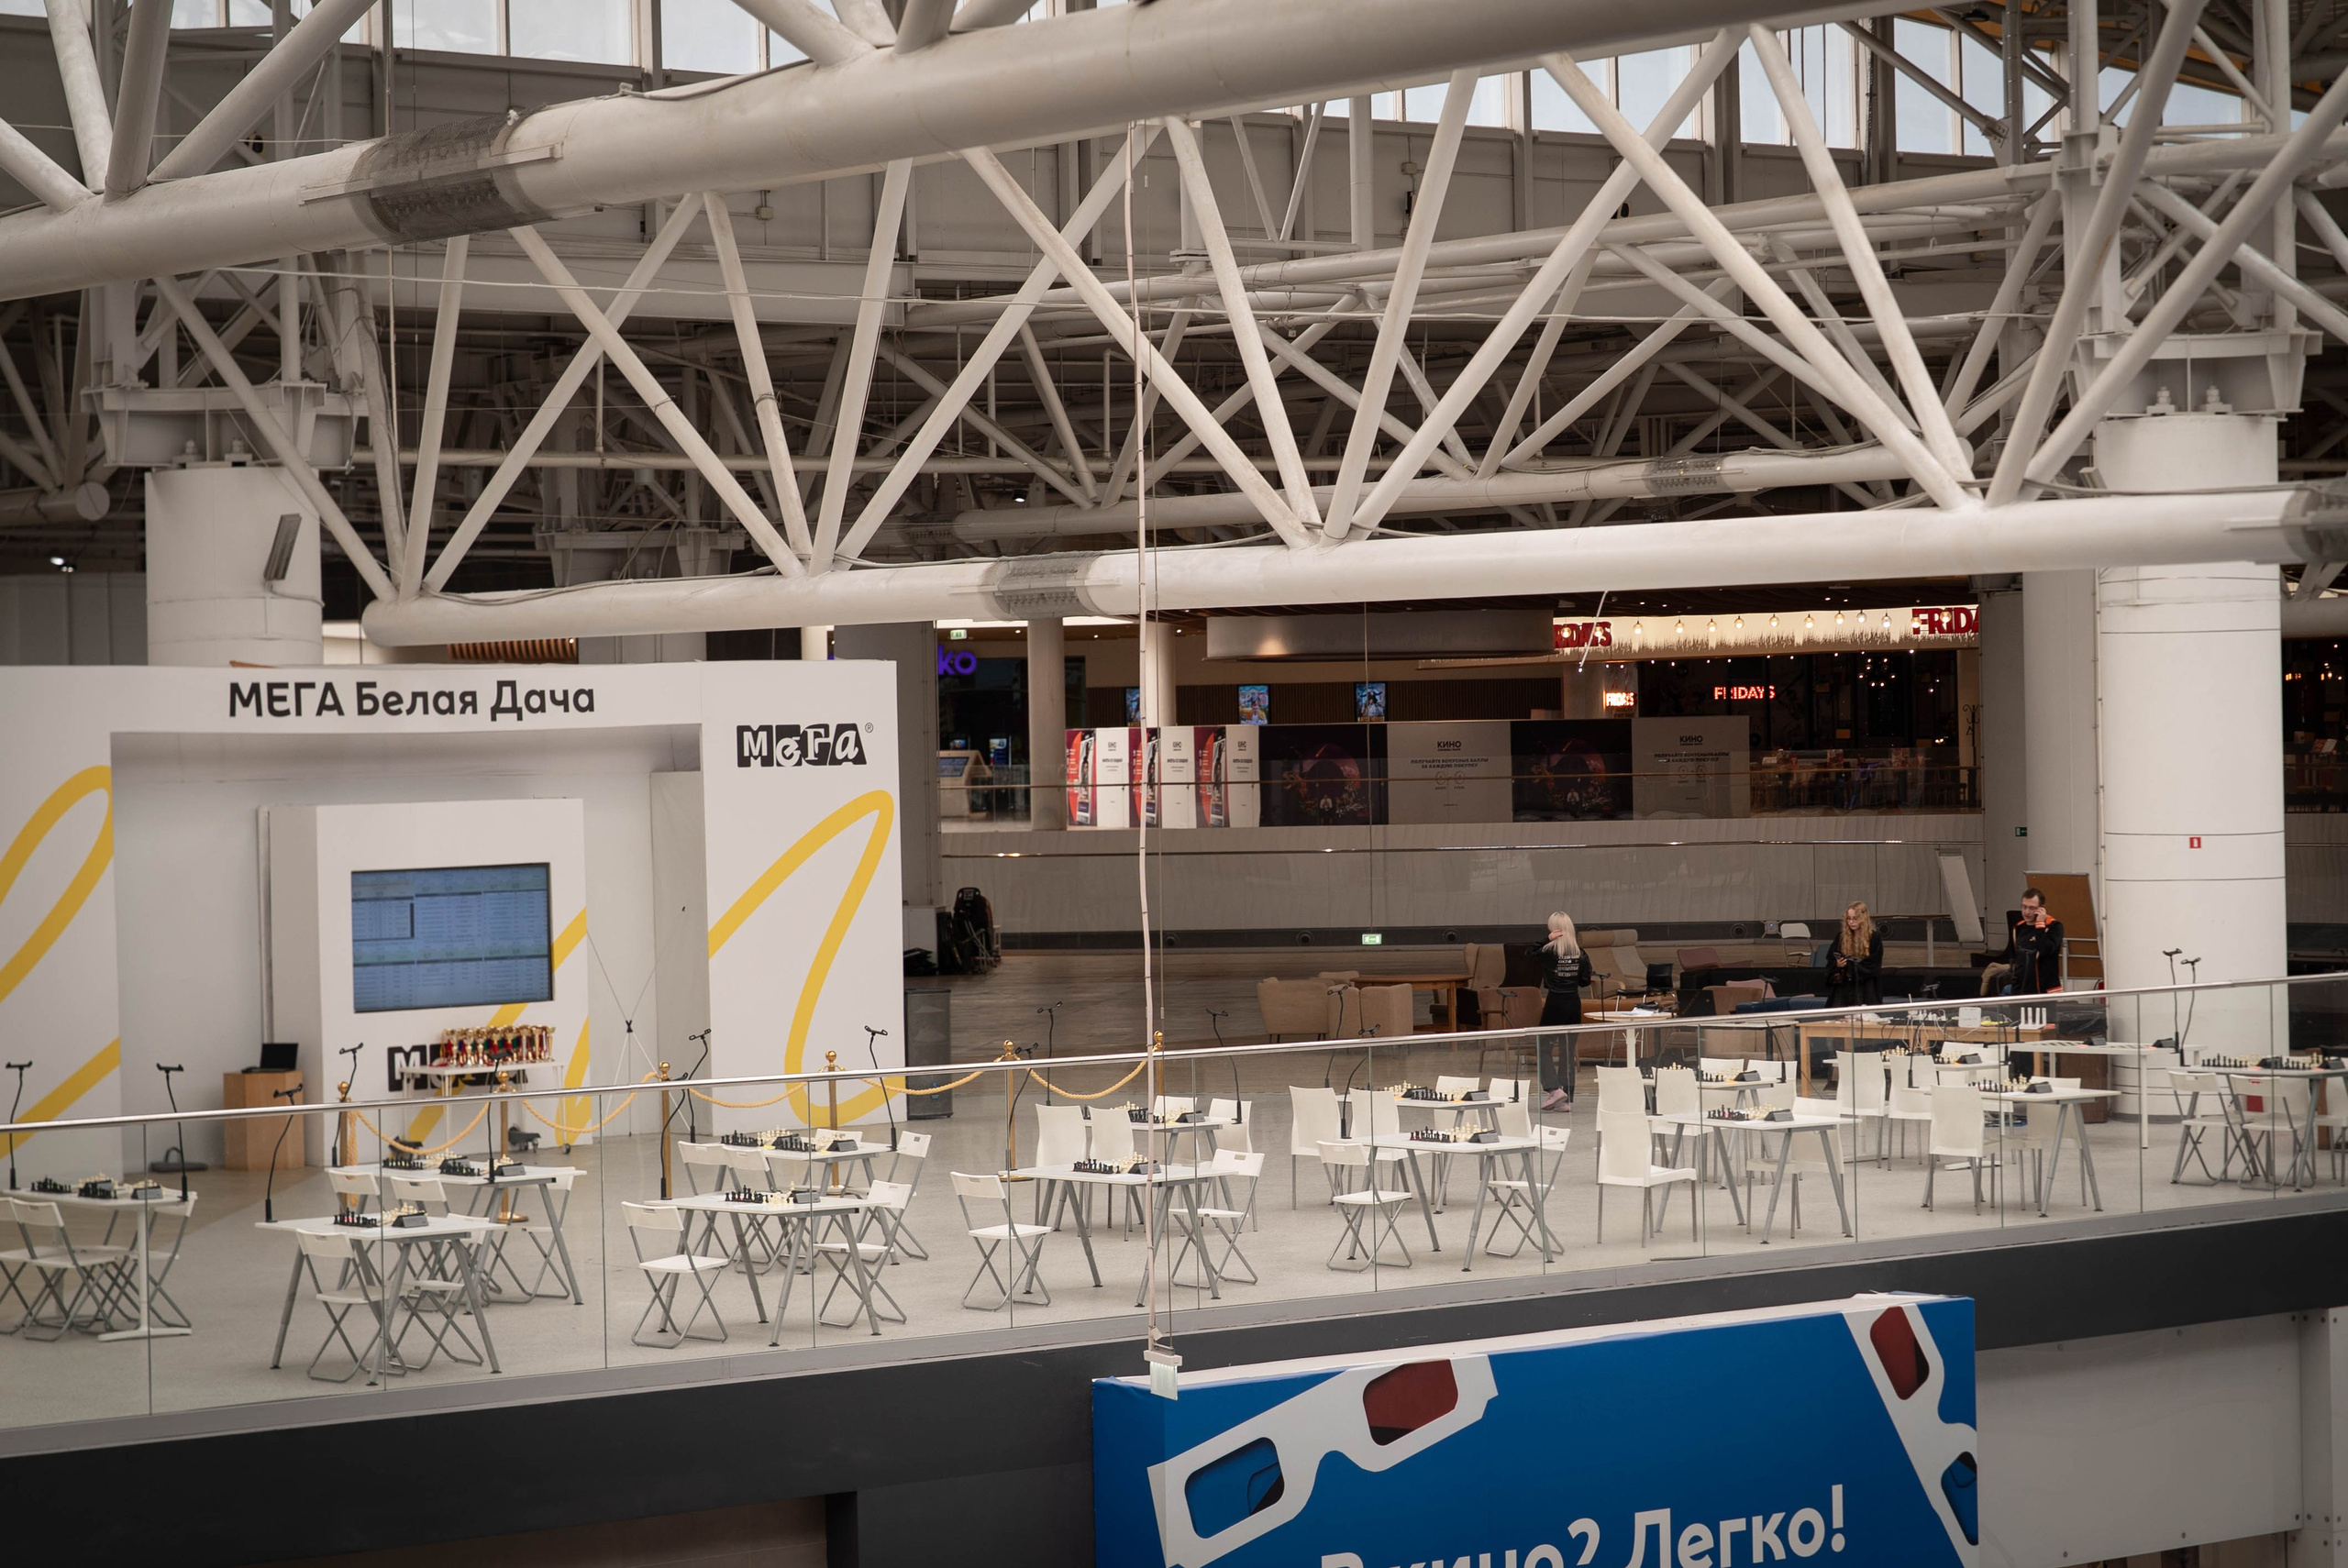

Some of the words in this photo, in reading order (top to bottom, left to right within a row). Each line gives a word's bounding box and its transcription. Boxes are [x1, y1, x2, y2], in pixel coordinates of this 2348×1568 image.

[1553, 622, 1612, 648] RIDAYS
[1912, 606, 1978, 635] FRID
[229, 681, 345, 717] МЕГА
[356, 681, 479, 716] Белая
[490, 680, 595, 722] Дача
[1437, 740, 1461, 748] КИНО
[1624, 1484, 1845, 1568] Легко!
